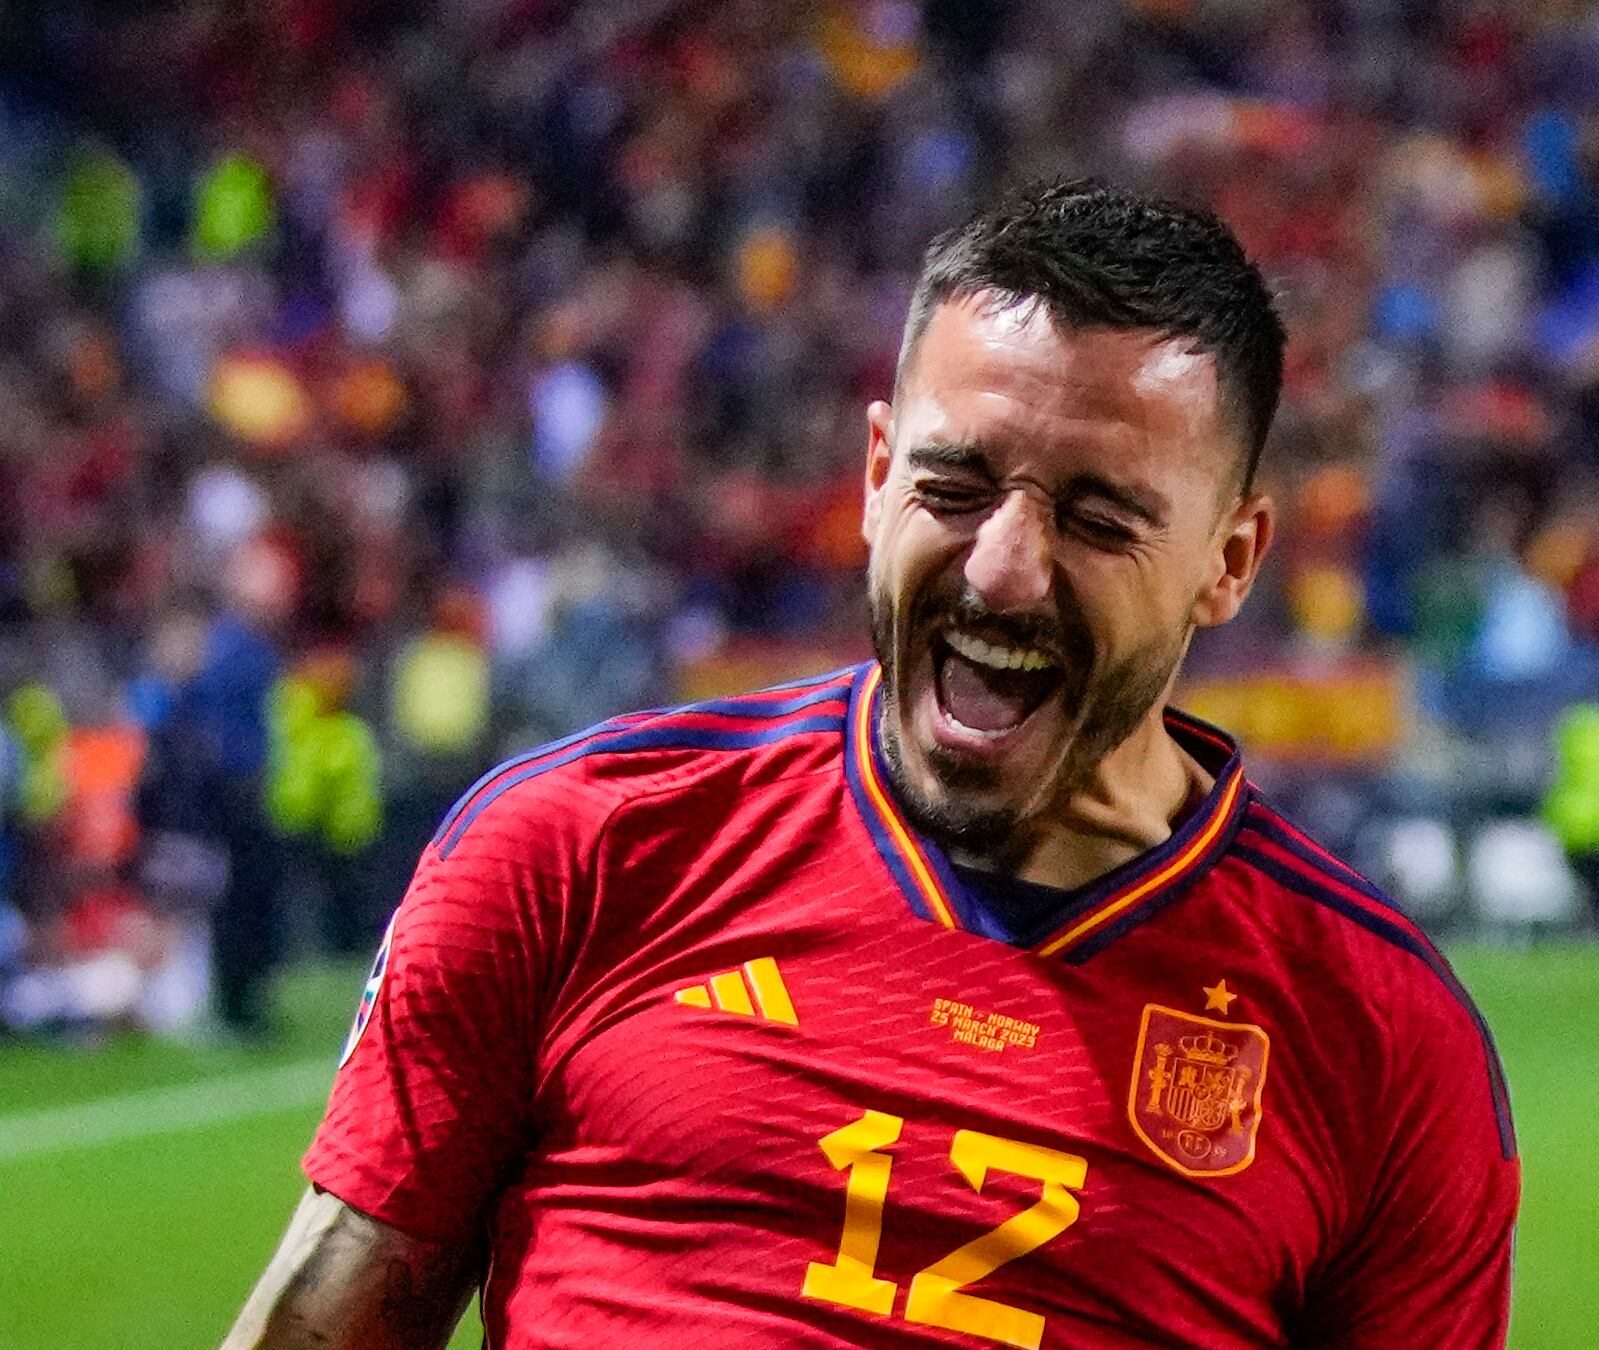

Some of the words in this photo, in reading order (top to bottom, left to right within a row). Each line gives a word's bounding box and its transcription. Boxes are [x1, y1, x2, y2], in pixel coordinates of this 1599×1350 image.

[931, 1010, 948, 1024] 25
[953, 1016, 997, 1036] MARCH
[1000, 1028, 1036, 1048] 2023
[934, 998, 973, 1018] SPAIN
[987, 1013, 1040, 1036] NORWAY
